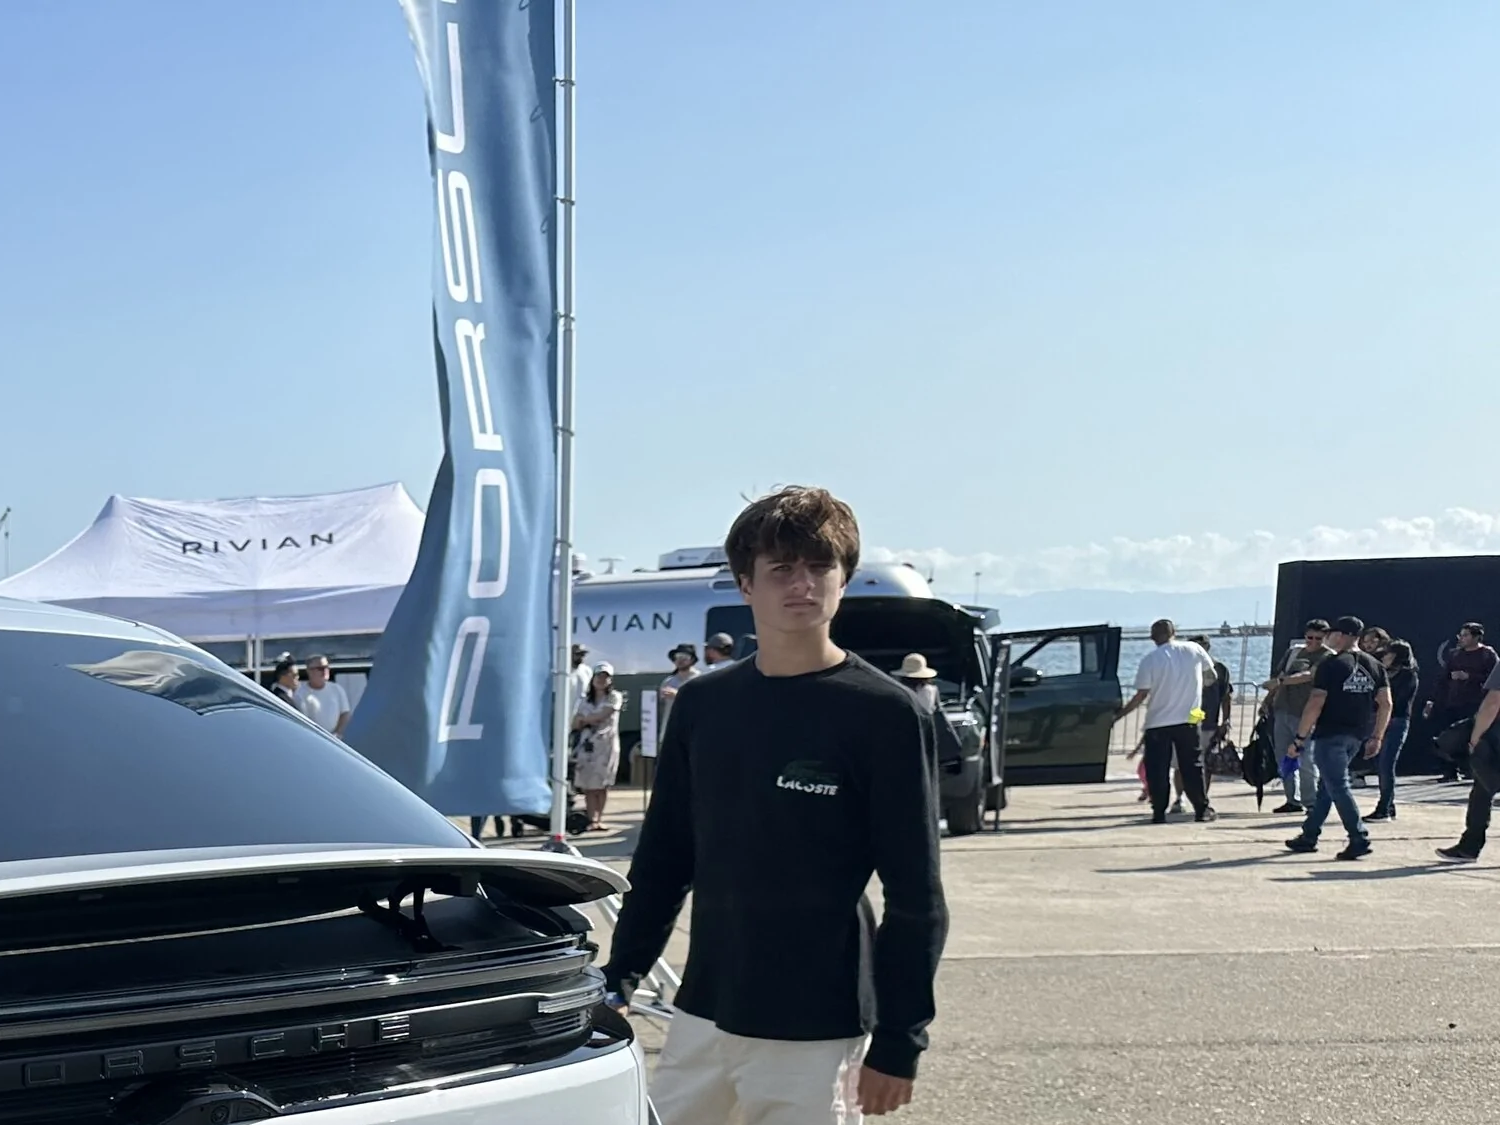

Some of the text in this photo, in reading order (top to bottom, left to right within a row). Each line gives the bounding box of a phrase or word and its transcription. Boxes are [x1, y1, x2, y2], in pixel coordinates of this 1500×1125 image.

[436, 0, 510, 742] PORSC
[182, 532, 334, 554] RIVIAN
[572, 611, 673, 634] IVIAN
[776, 775, 838, 796] LACOSTE
